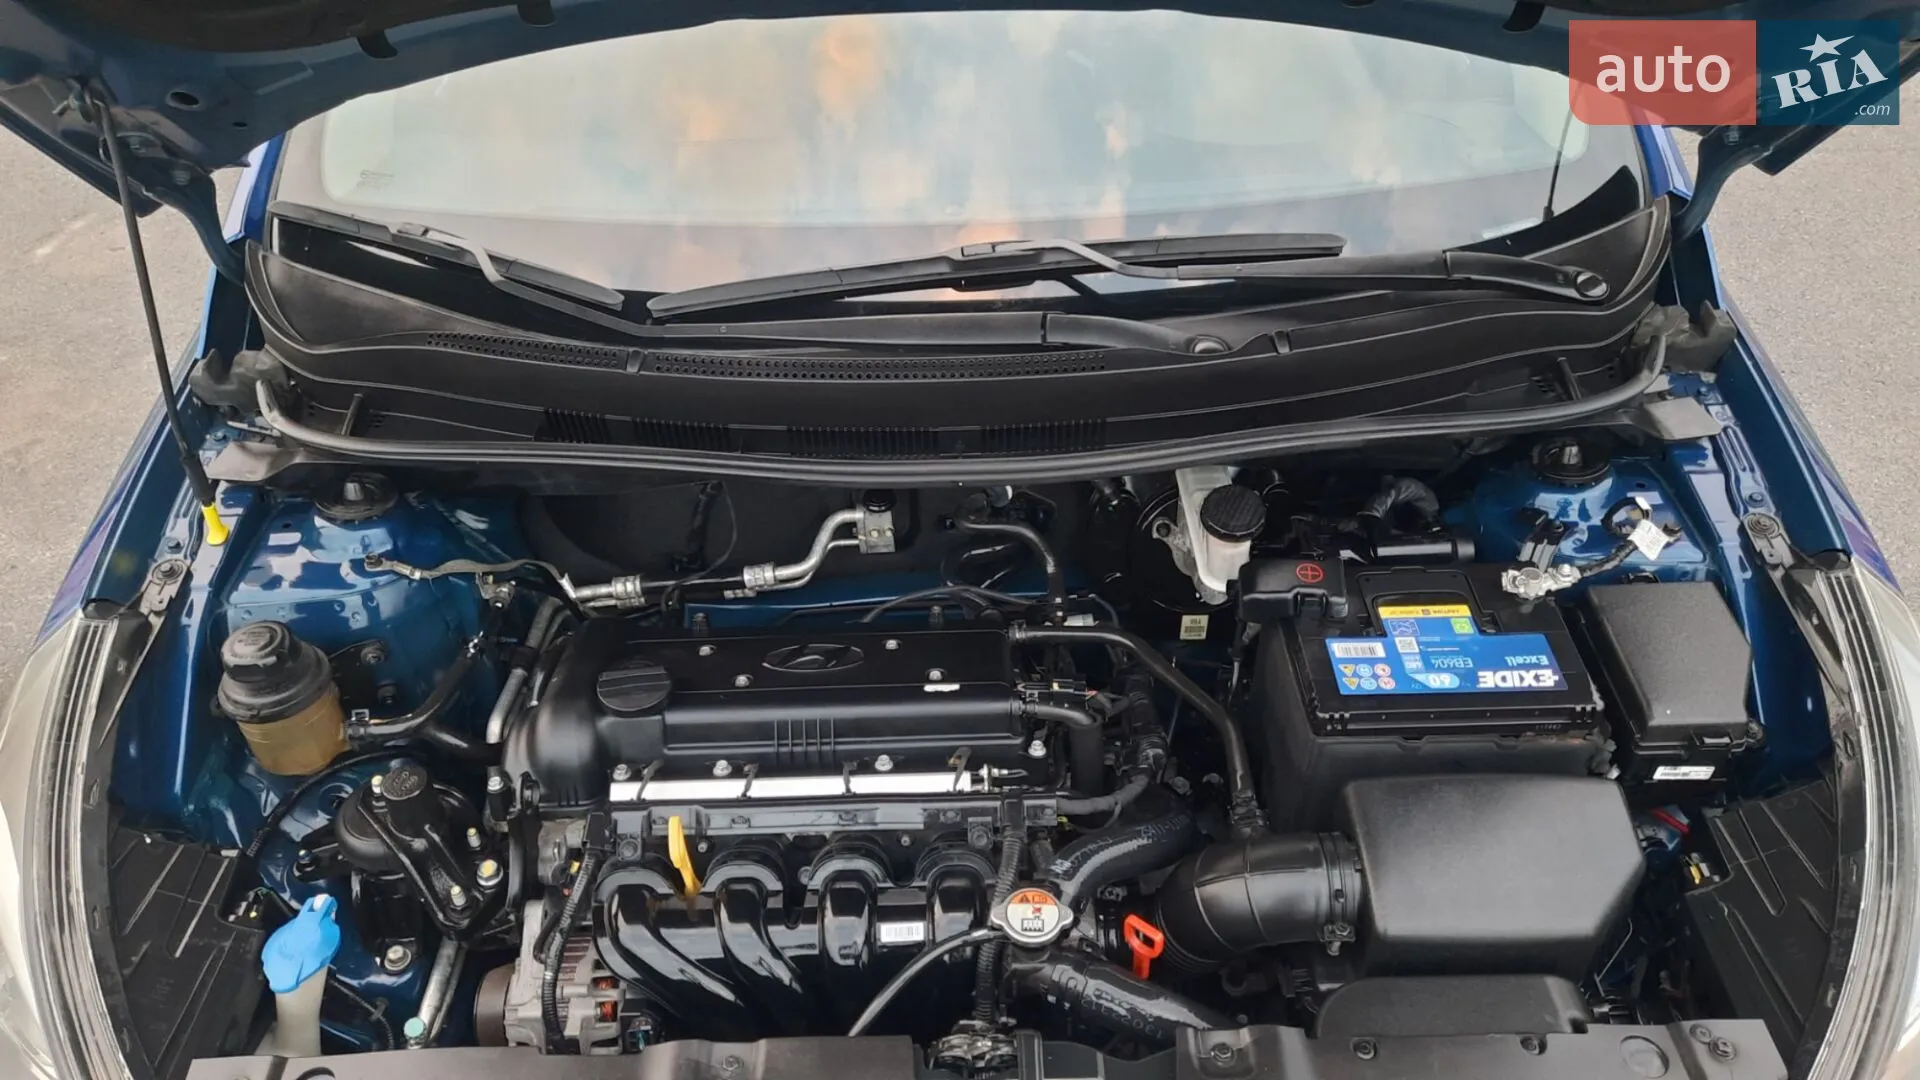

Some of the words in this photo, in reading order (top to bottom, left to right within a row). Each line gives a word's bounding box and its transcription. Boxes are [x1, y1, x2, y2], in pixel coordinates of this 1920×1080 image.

[1432, 657, 1474, 669] EB604
[1504, 655, 1549, 667] Excell
[1428, 674, 1452, 687] 60
[1476, 669, 1559, 688] EXIDE
